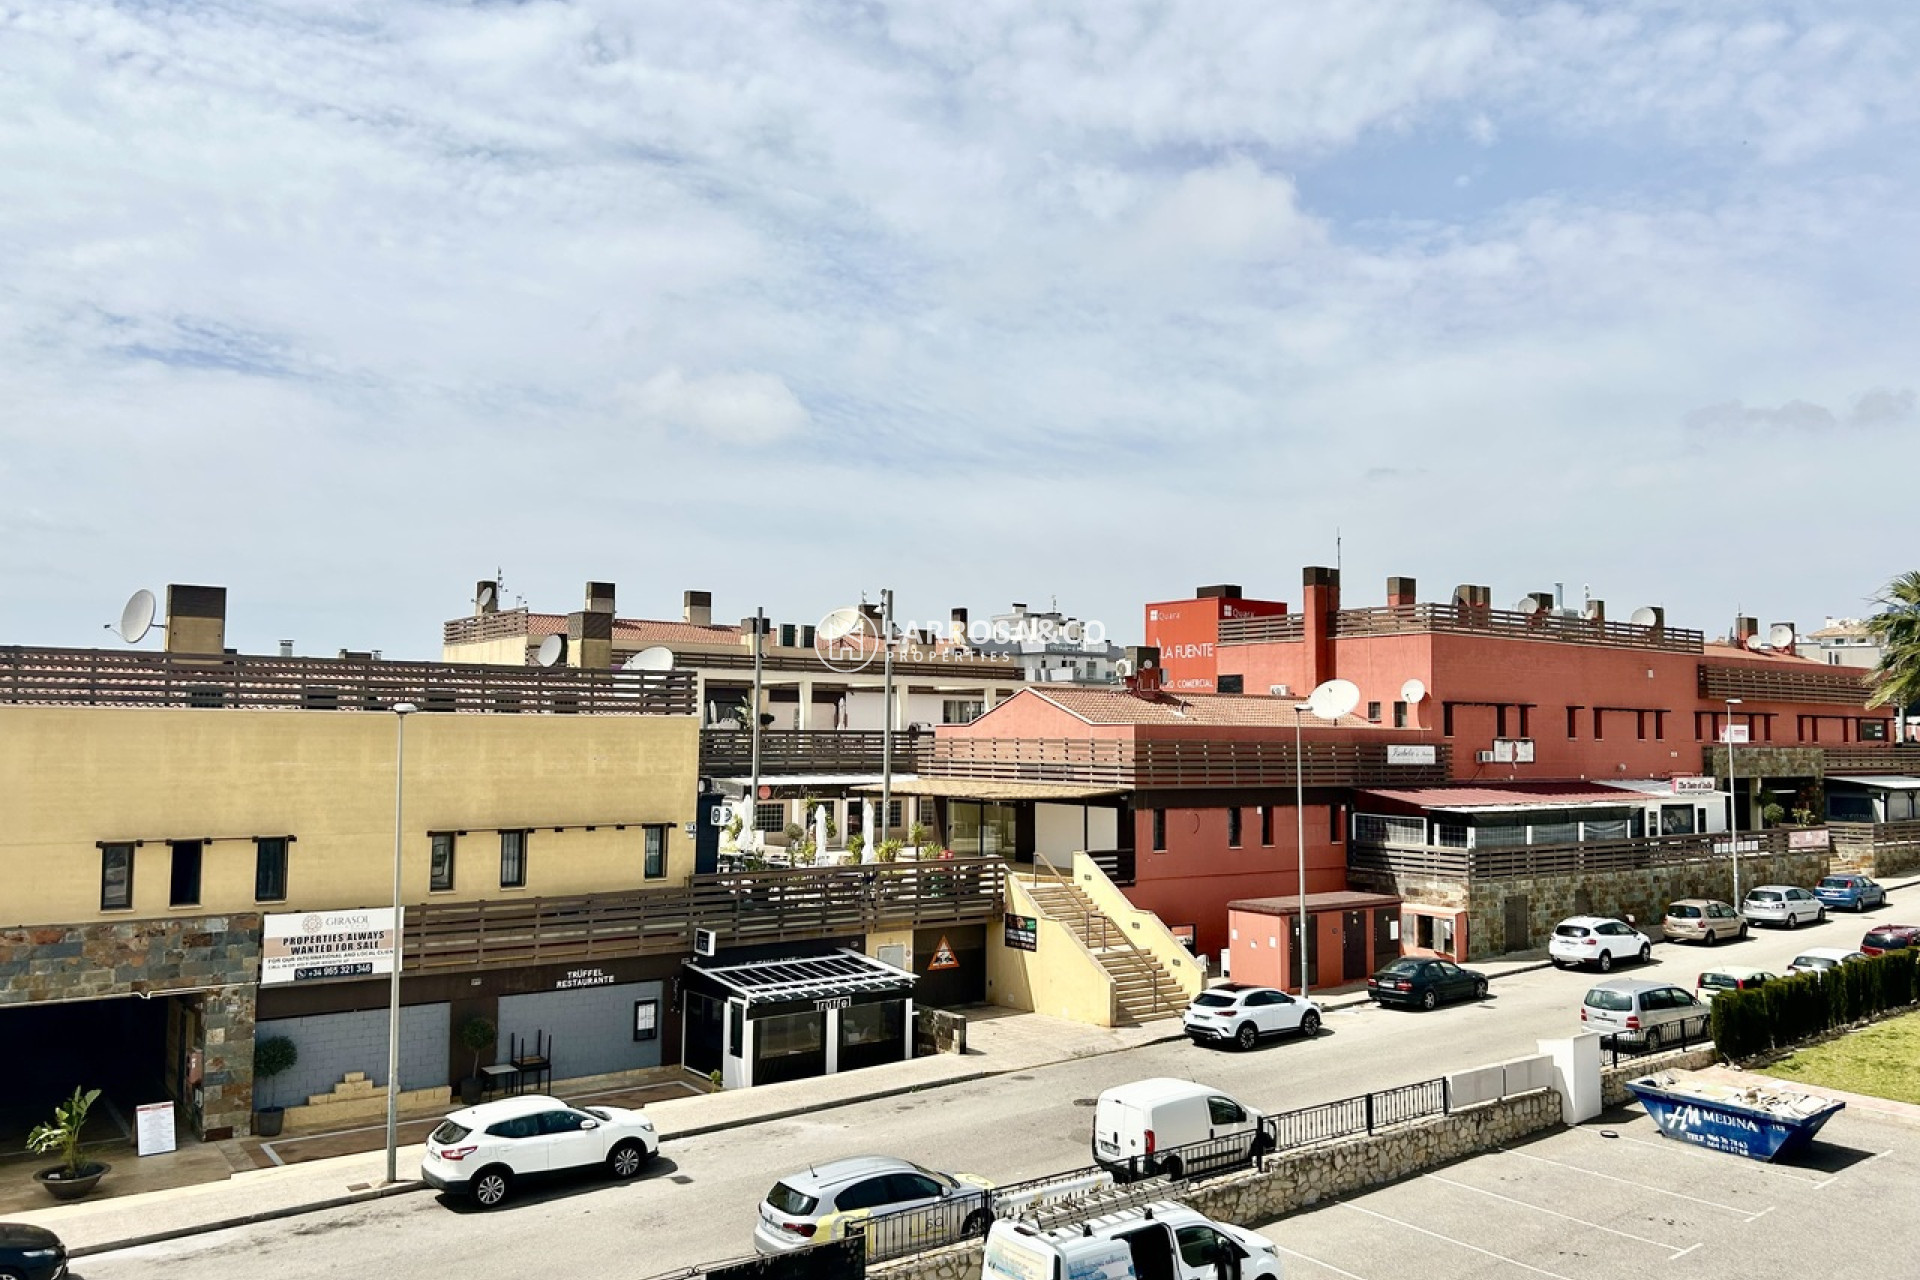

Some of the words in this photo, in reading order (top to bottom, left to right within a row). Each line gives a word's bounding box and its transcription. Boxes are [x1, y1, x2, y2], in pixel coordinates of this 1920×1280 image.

[1160, 645, 1174, 659] LA
[1176, 643, 1214, 659] FUENTE
[325, 915, 369, 926] GIRASOL
[283, 933, 344, 947] PROPERTIES
[347, 930, 385, 941] ALWAYS
[291, 943, 332, 955] WANTED
[335, 942, 354, 953] FOR
[357, 940, 379, 950] SALE
[556, 975, 615, 989] RESTAURANTE
[1703, 1109, 1759, 1132] MEDINA
